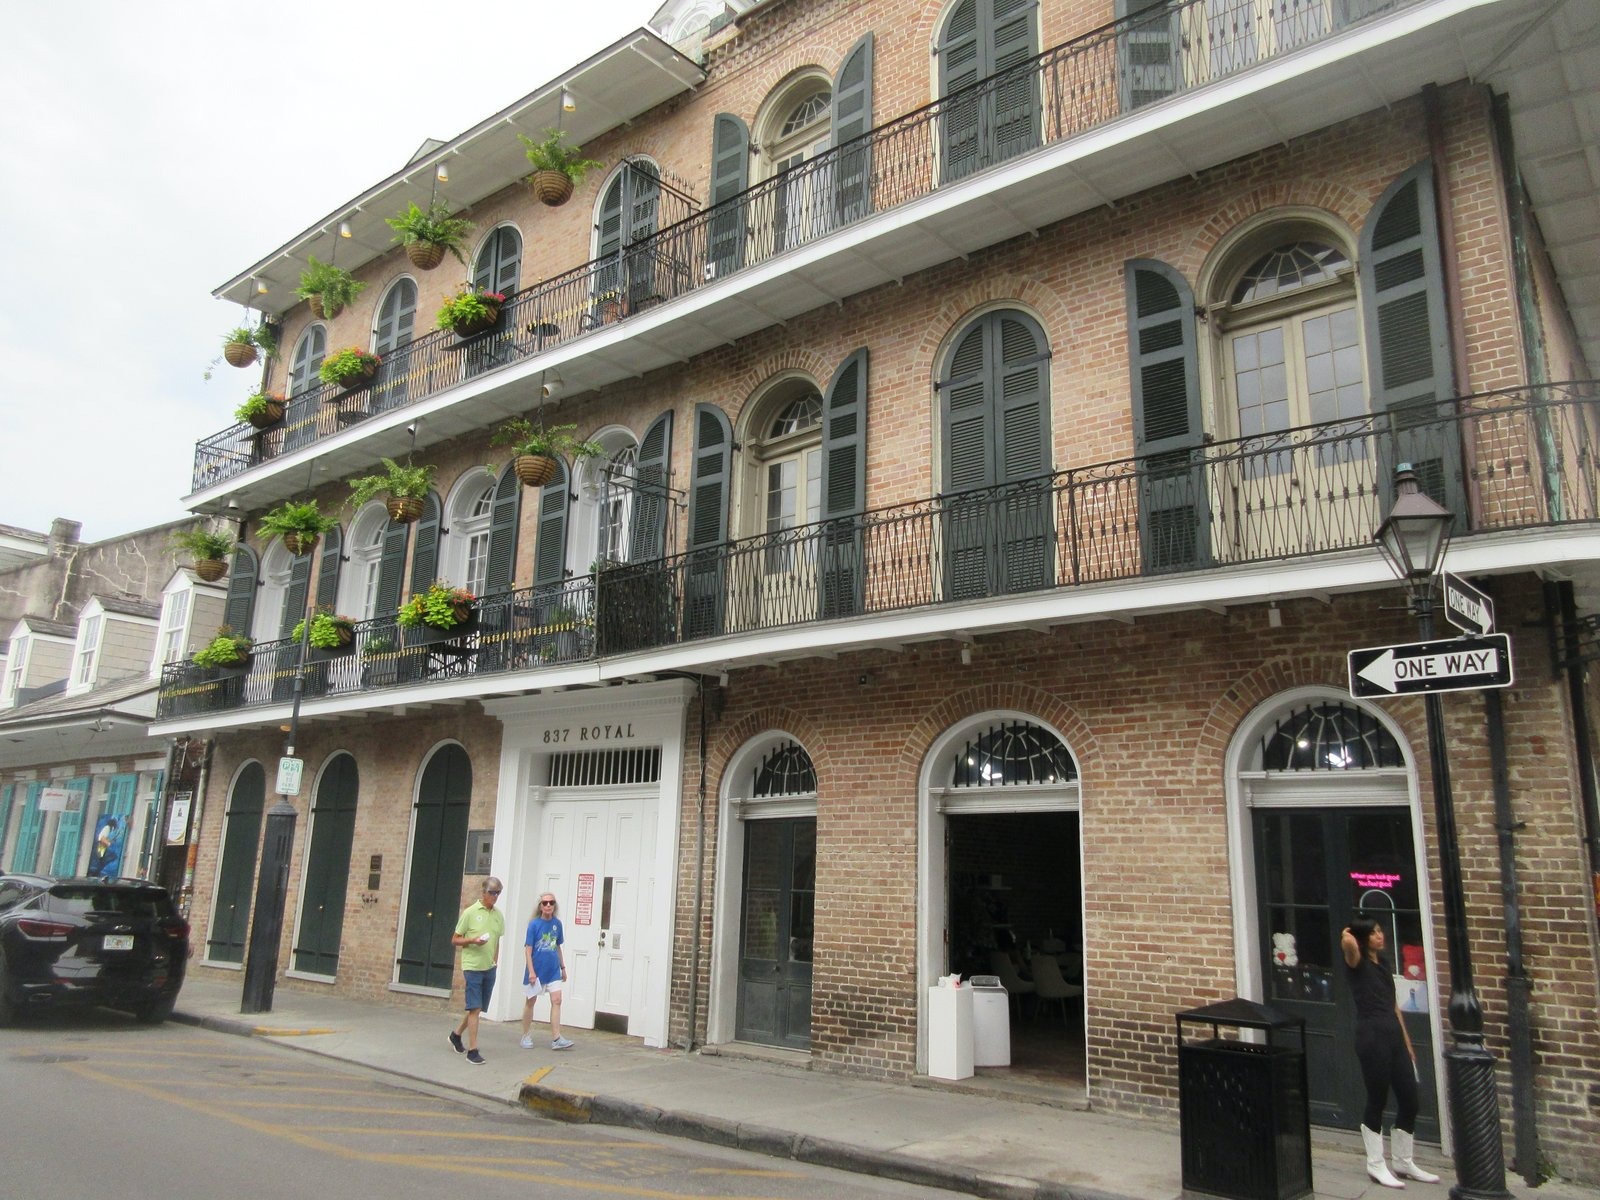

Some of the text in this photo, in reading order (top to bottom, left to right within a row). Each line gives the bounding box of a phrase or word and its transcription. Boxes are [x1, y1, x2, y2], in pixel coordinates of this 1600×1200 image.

[1450, 588, 1480, 623] ONE WAY
[1395, 651, 1490, 679] ONE WAY
[543, 723, 635, 744] 837 ROYAL
